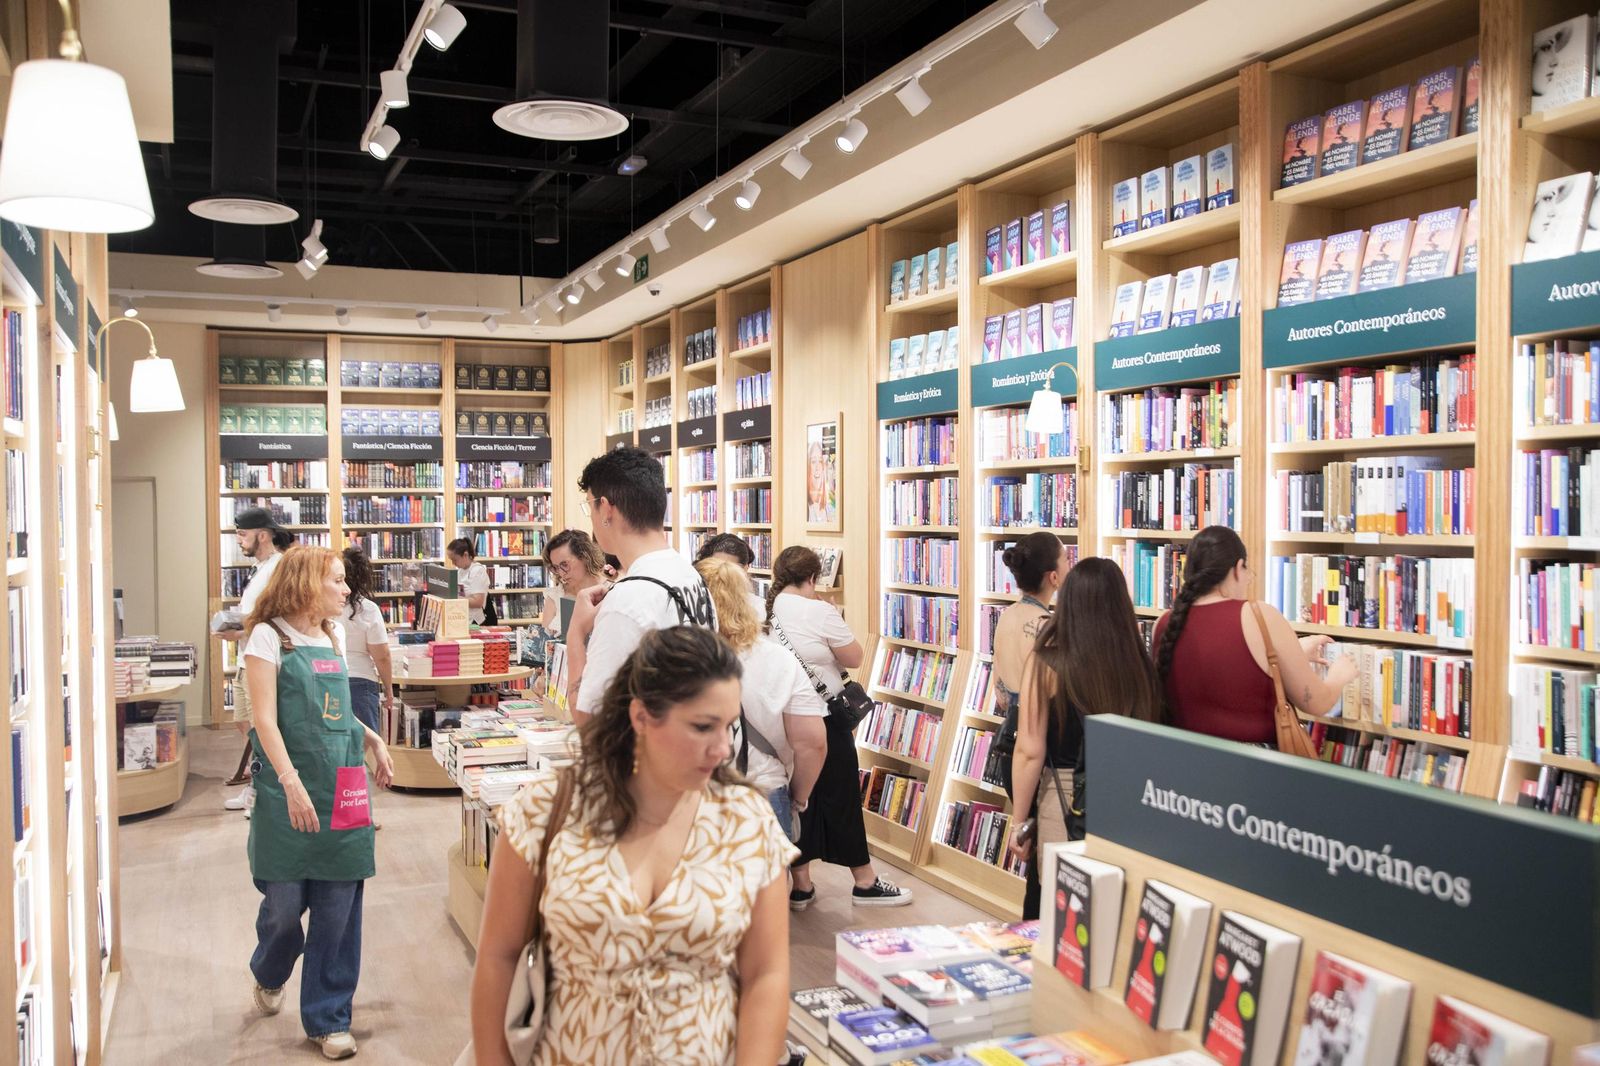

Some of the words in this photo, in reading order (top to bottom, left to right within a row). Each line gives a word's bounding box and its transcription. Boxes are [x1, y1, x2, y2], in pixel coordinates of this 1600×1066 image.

[1422, 72, 1448, 86] ISABEL
[1376, 89, 1402, 103] ISABEL
[1417, 80, 1453, 98] ALLENDE
[1330, 104, 1356, 117] ISABEL
[1372, 98, 1407, 114] ALLENDE
[1290, 119, 1314, 131] ISABEL
[1326, 113, 1360, 128] ALLENDE
[1424, 114, 1445, 127] NOMBRE
[1287, 127, 1318, 142] ALLENDE
[1376, 130, 1397, 142] NOMBRE
[1424, 210, 1452, 222] ISABEL
[1376, 221, 1402, 234] ISABEL
[1420, 220, 1456, 234] ALLENDE
[1548, 281, 1600, 302] Autor
[1288, 324, 1332, 342] Autores
[1334, 306, 1446, 335] Contemporáneos
[1112, 356, 1143, 369] Autores
[1144, 344, 1221, 364] Contemporáneos
[992, 374, 1026, 388] Romántica
[1026, 375, 1030, 386] y
[1030, 369, 1055, 382] Erótia
[894, 391, 919, 403] Romántica
[919, 392, 923, 402] y
[922, 388, 942, 399] Erótica
[258, 442, 292, 450] Fantástica
[352, 442, 384, 450] Fantástica
[386, 442, 410, 450] Ciencia
[410, 442, 432, 450] Ficción
[518, 444, 536, 452] Terror
[343, 789, 367, 798] Gracias
[340, 800, 354, 808] por
[1141, 779, 1224, 828] Autores
[1226, 803, 1472, 908] Contemporáneos
[1058, 870, 1089, 898] ATWOOD
[1142, 896, 1171, 928] ATWOOD
[1224, 922, 1260, 949] MARGARET
[1219, 930, 1262, 968] ATWOOD
